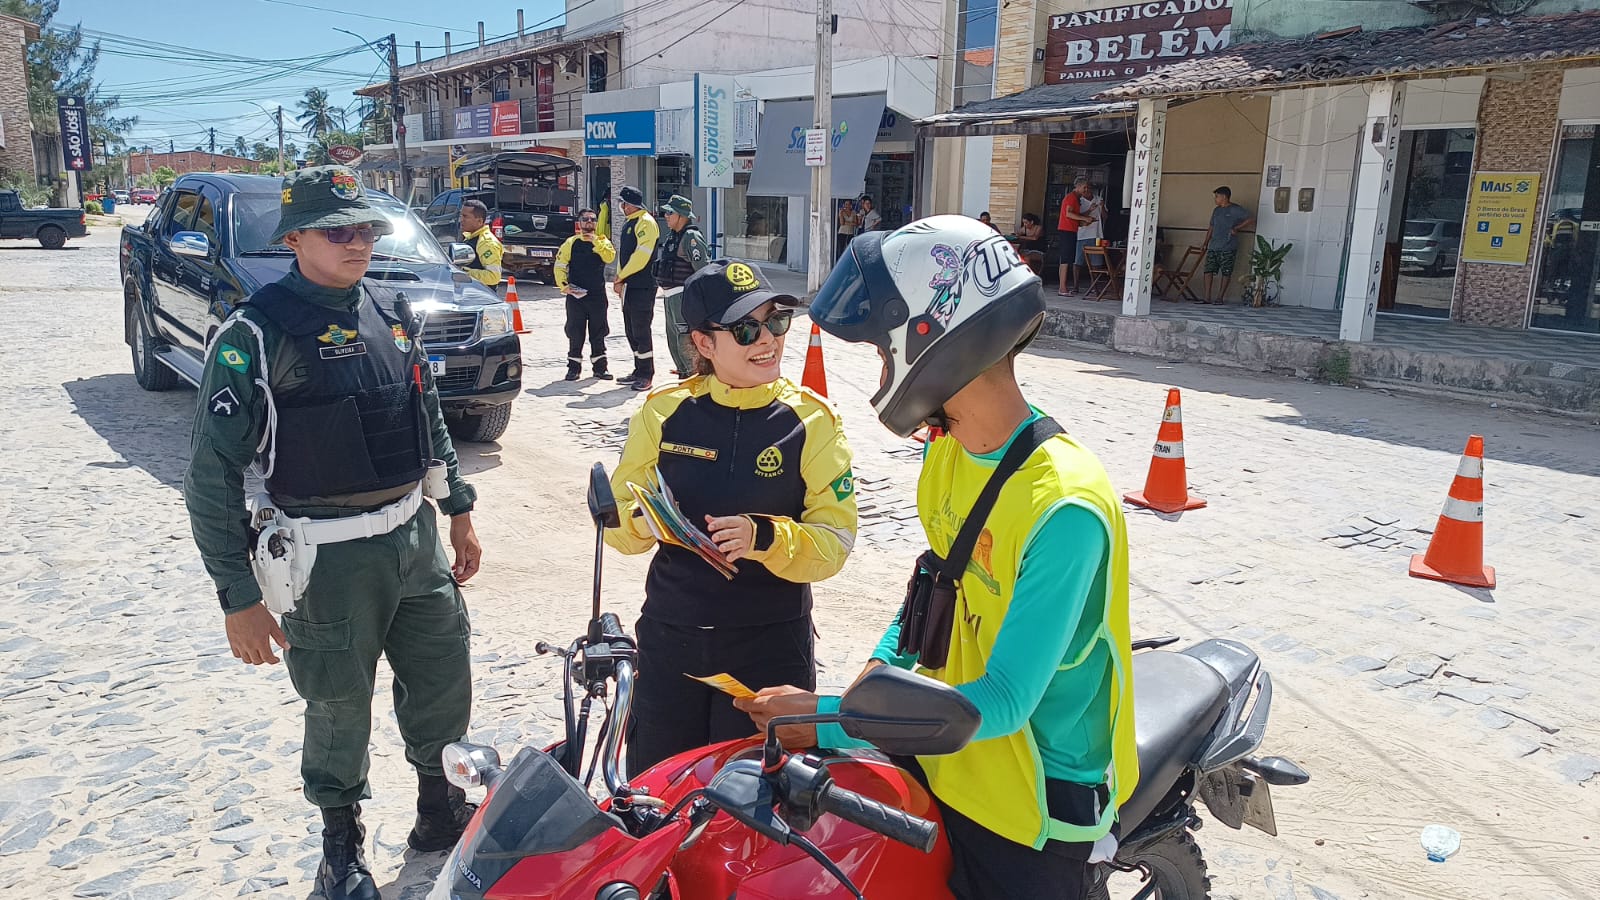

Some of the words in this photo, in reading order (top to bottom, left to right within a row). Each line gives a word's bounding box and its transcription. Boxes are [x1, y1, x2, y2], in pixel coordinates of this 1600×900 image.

[1052, 0, 1232, 30] PANIFICADO
[1064, 16, 1231, 66] BELÉM
[1060, 69, 1116, 80] PADARIA
[1124, 67, 1135, 75] &
[65, 110, 80, 134] JOSÉ
[704, 86, 726, 164] Sampaio
[69, 136, 82, 157] SÃO
[788, 127, 841, 149] Saio
[1383, 91, 1401, 194] ADEGA
[1367, 260, 1381, 317] BAR
[672, 445, 695, 455] PONTE
[1154, 443, 1170, 453] ETRAN
